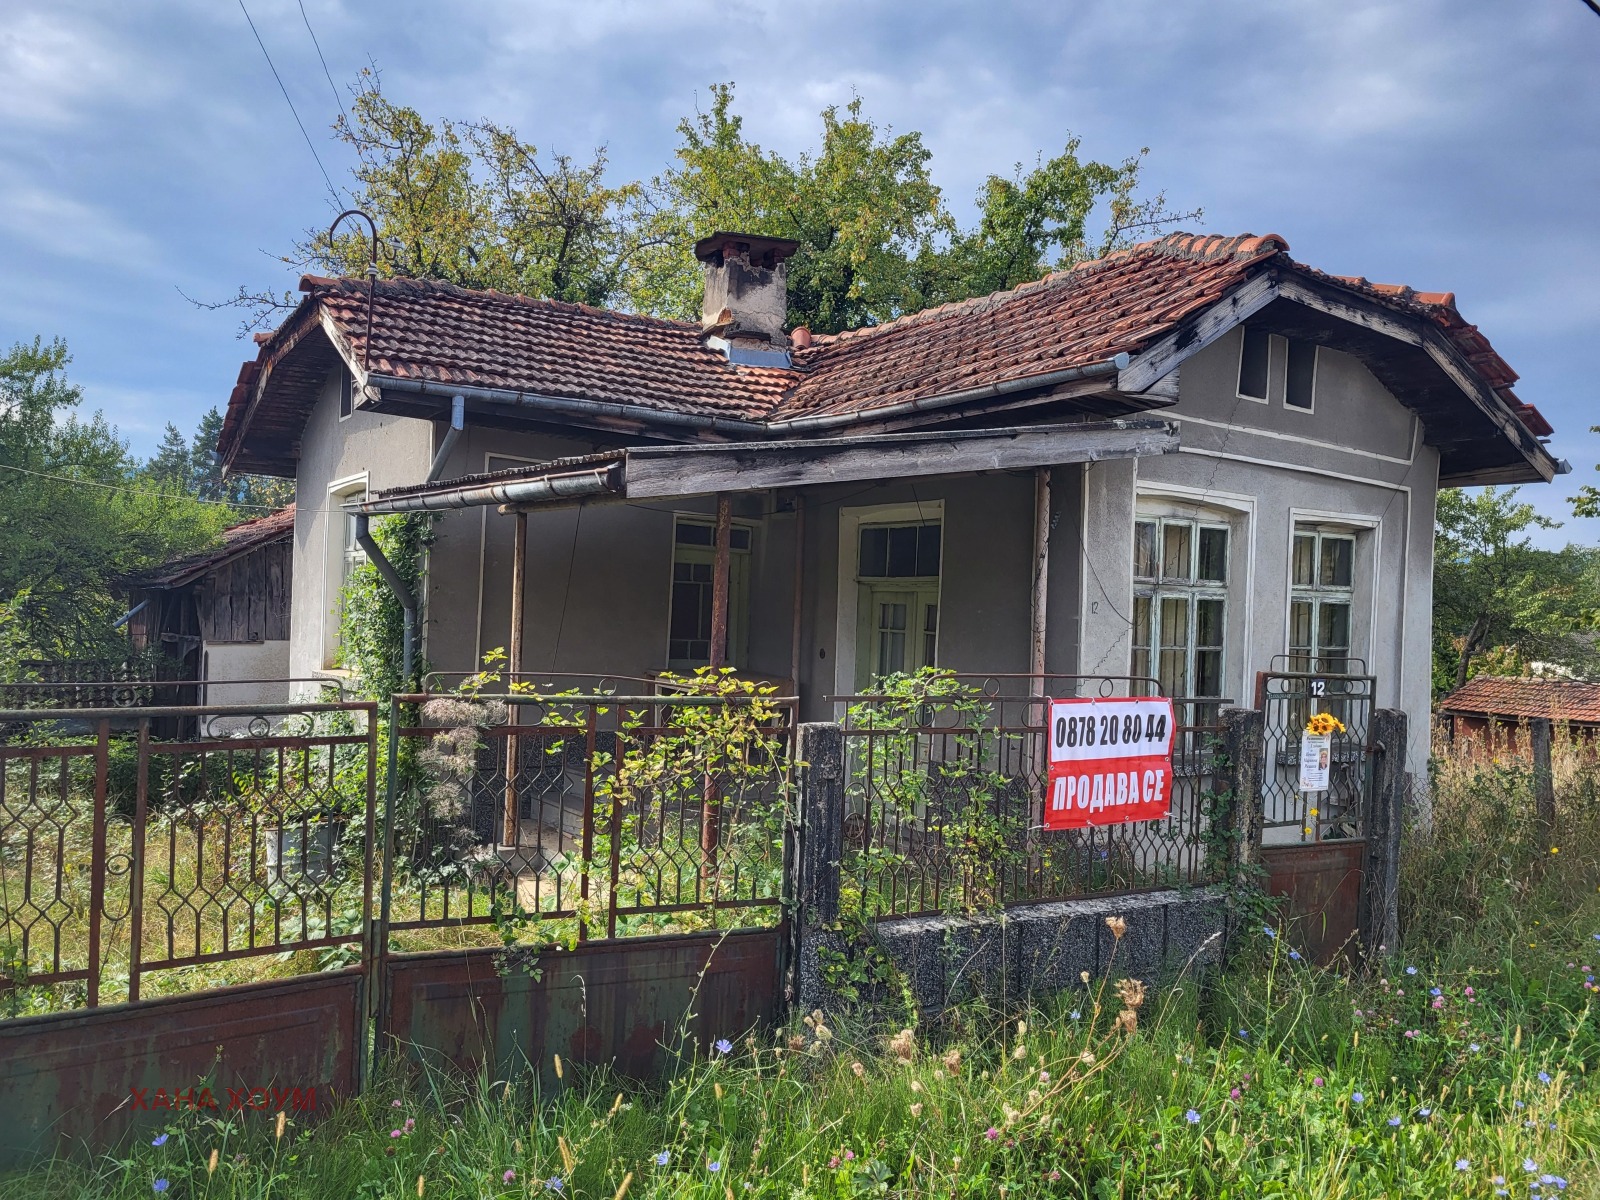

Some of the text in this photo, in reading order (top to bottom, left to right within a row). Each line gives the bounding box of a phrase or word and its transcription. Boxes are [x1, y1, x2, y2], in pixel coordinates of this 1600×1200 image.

[1091, 601, 1099, 615] 12
[1311, 681, 1325, 696] 12
[1055, 714, 1167, 748] 0878 20 80 44
[1052, 769, 1165, 814] ПРОДАВА СЕ
